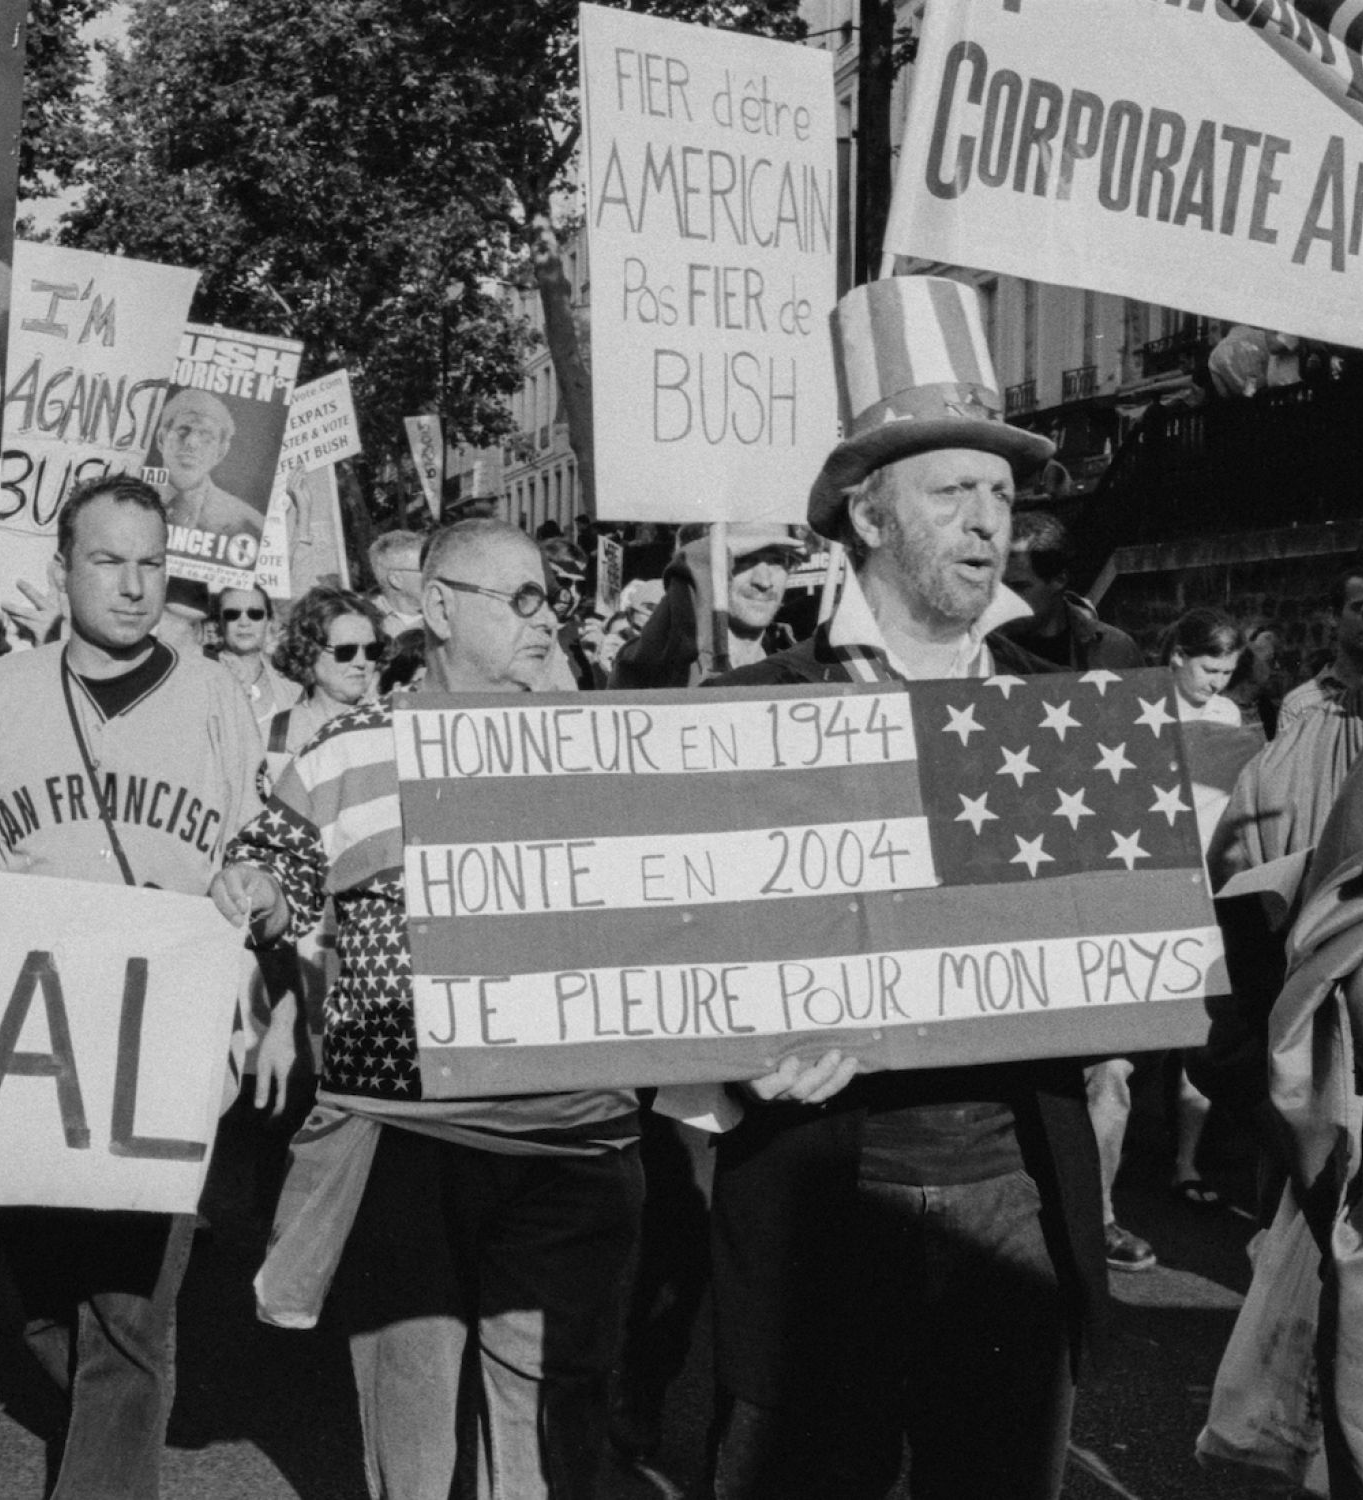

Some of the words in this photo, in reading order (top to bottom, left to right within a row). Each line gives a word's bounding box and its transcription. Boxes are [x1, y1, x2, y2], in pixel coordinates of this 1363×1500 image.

[615, 48, 692, 122] FIER
[713, 69, 811, 141] d'être
[925, 40, 1291, 246] CORPORATE
[596, 139, 833, 254] AMERICAIN
[20, 277, 116, 347] I'M
[623, 257, 678, 326] Pas
[687, 263, 767, 332] FIER
[779, 282, 812, 336] de
[184, 335, 302, 378] USH
[653, 348, 797, 446] BUSH
[5, 352, 168, 450] AGAINST
[290, 400, 338, 429] EXPATS
[322, 415, 349, 433] VOTE
[314, 435, 348, 458] BUSH
[414, 704, 663, 778] HONNEUR
[682, 725, 738, 771] EN
[767, 695, 902, 770] 1944
[422, 841, 602, 917] HONTE
[643, 854, 716, 902] EN
[761, 823, 911, 897] 2004
[427, 976, 516, 1047] JE
[557, 964, 758, 1043] PLEURE
[779, 958, 914, 1027] POUR
[937, 948, 1052, 1018] MON
[1080, 936, 1206, 1006] PAYS
